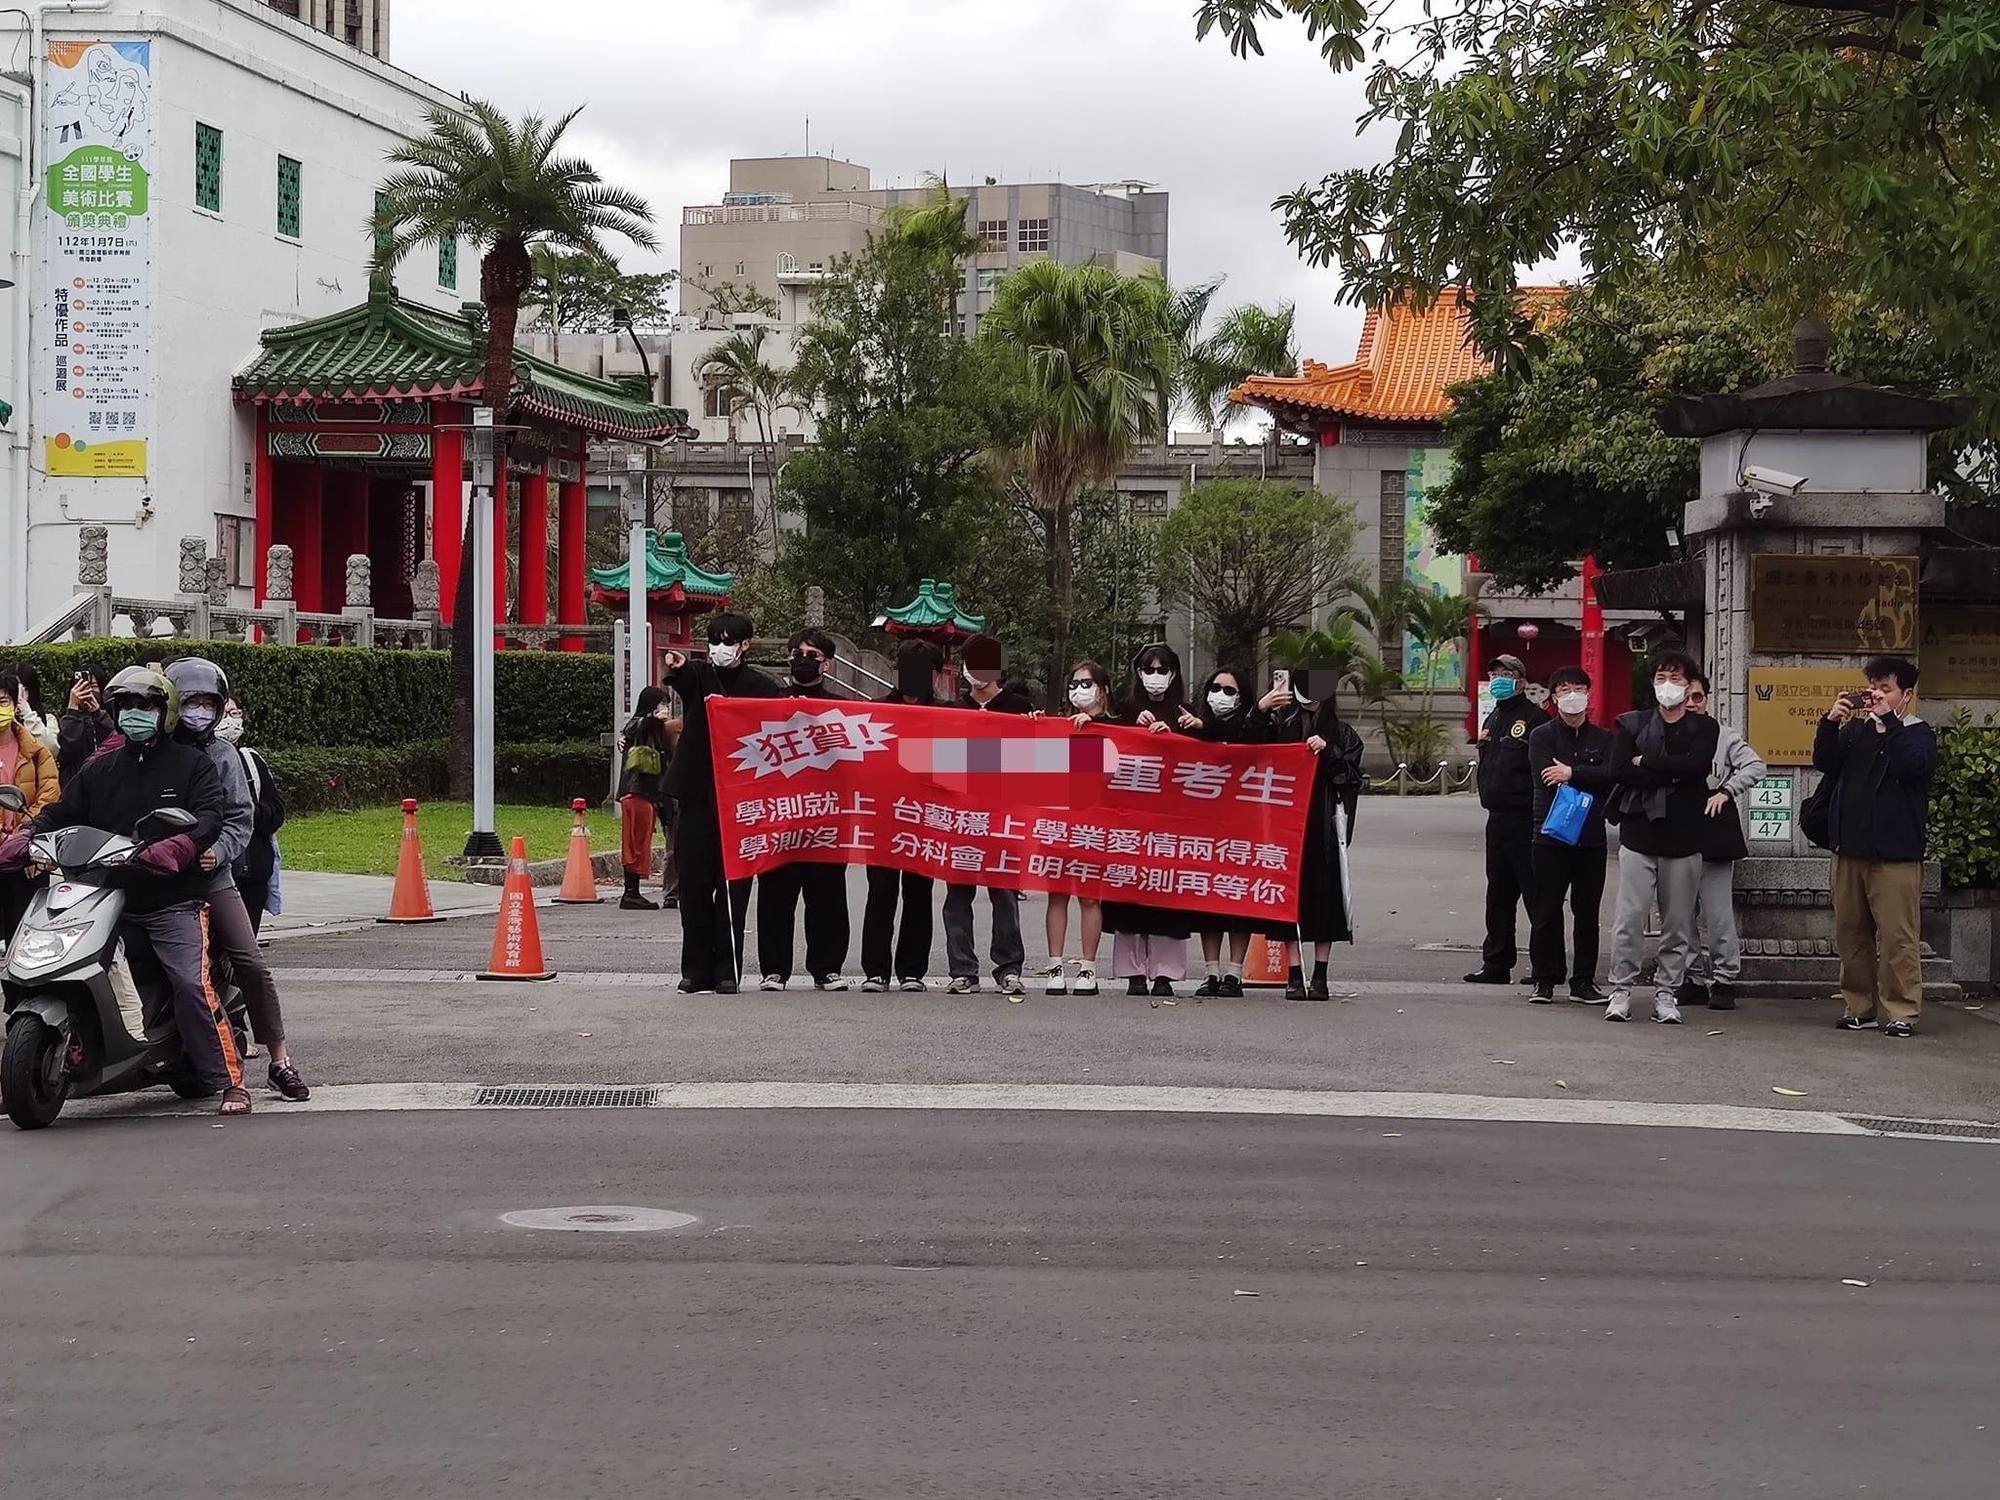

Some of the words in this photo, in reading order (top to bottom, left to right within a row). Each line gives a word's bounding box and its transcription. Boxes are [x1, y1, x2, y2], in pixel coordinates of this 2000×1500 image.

[63, 165, 133, 183] 全國學生
[63, 190, 133, 208] 美術比賽
[66, 213, 127, 229] 頒獎典禮
[55, 288, 69, 347] 特優作品
[56, 355, 68, 391] 巡迴展
[756, 719, 876, 767] 狂賀!
[1107, 753, 1298, 808] 重考生
[1759, 790, 1783, 805] 43
[734, 790, 878, 827] 學測就上
[892, 796, 1027, 842] 台藝穩上
[1032, 816, 1290, 872] 學業愛情兩得意
[1758, 822, 1782, 837] 47
[738, 824, 876, 863] 學測沒上
[891, 832, 1022, 877] 分科會上
[1028, 855, 1287, 906] 明年學測再等你
